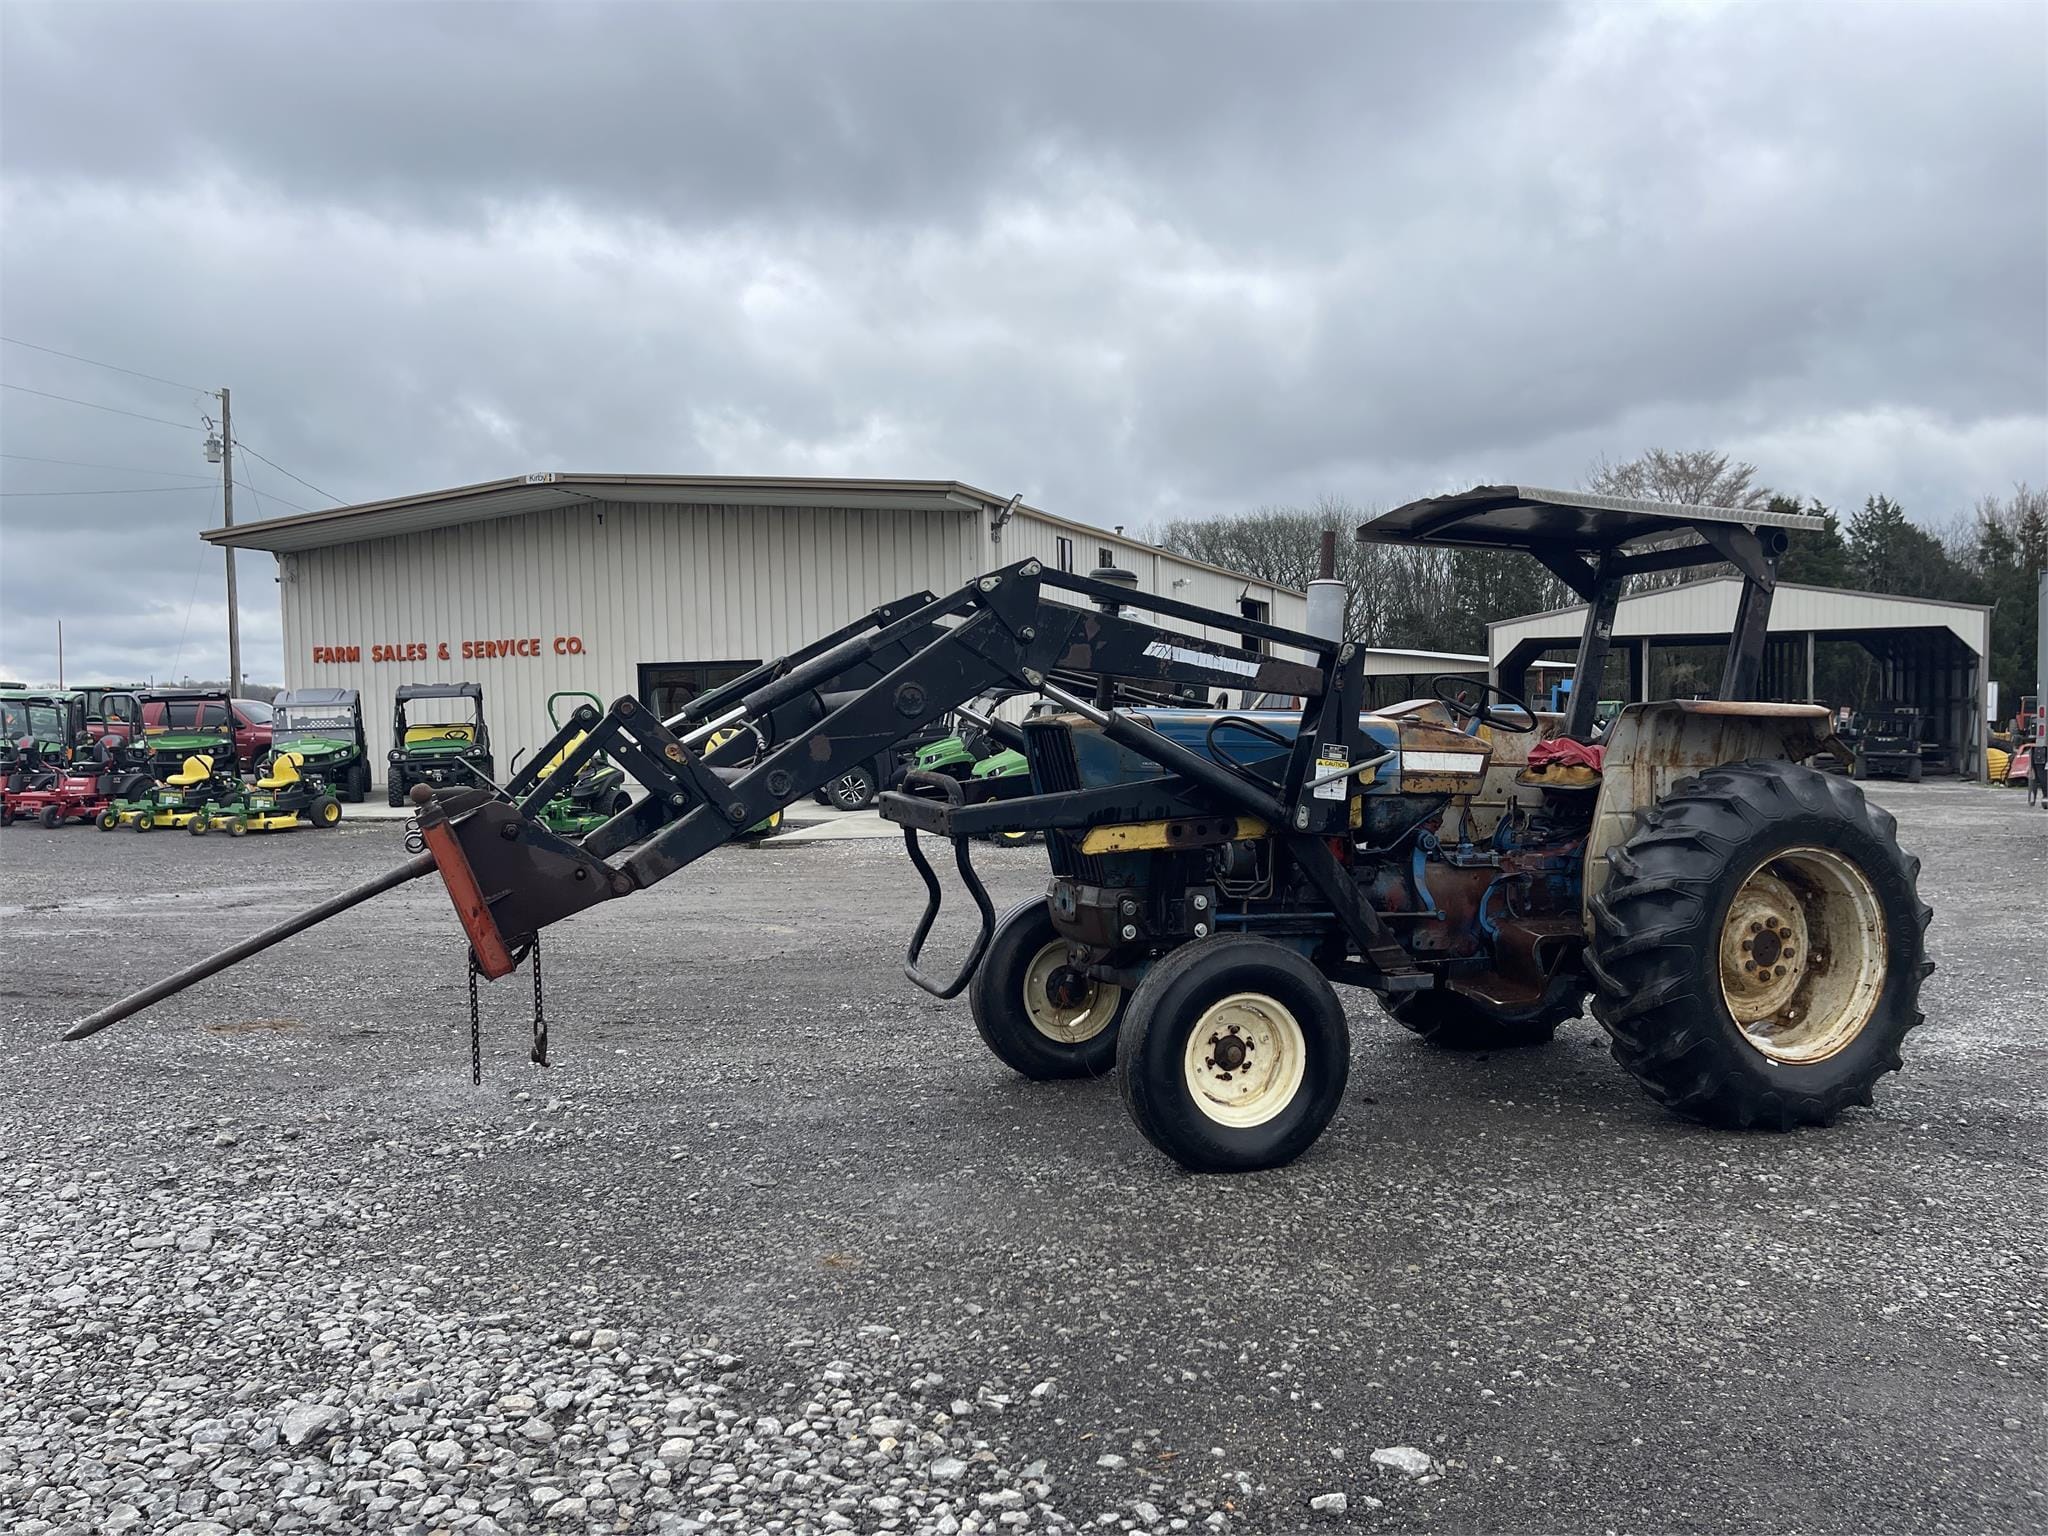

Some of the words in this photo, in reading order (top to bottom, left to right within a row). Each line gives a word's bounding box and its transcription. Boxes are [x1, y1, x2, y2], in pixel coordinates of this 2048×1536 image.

[313, 646, 360, 663] FARM
[371, 643, 427, 662] SALES
[437, 643, 450, 660] &
[462, 638, 540, 658] SERVICE
[553, 637, 586, 655] CO.
[1324, 760, 1347, 768] CAUTION
